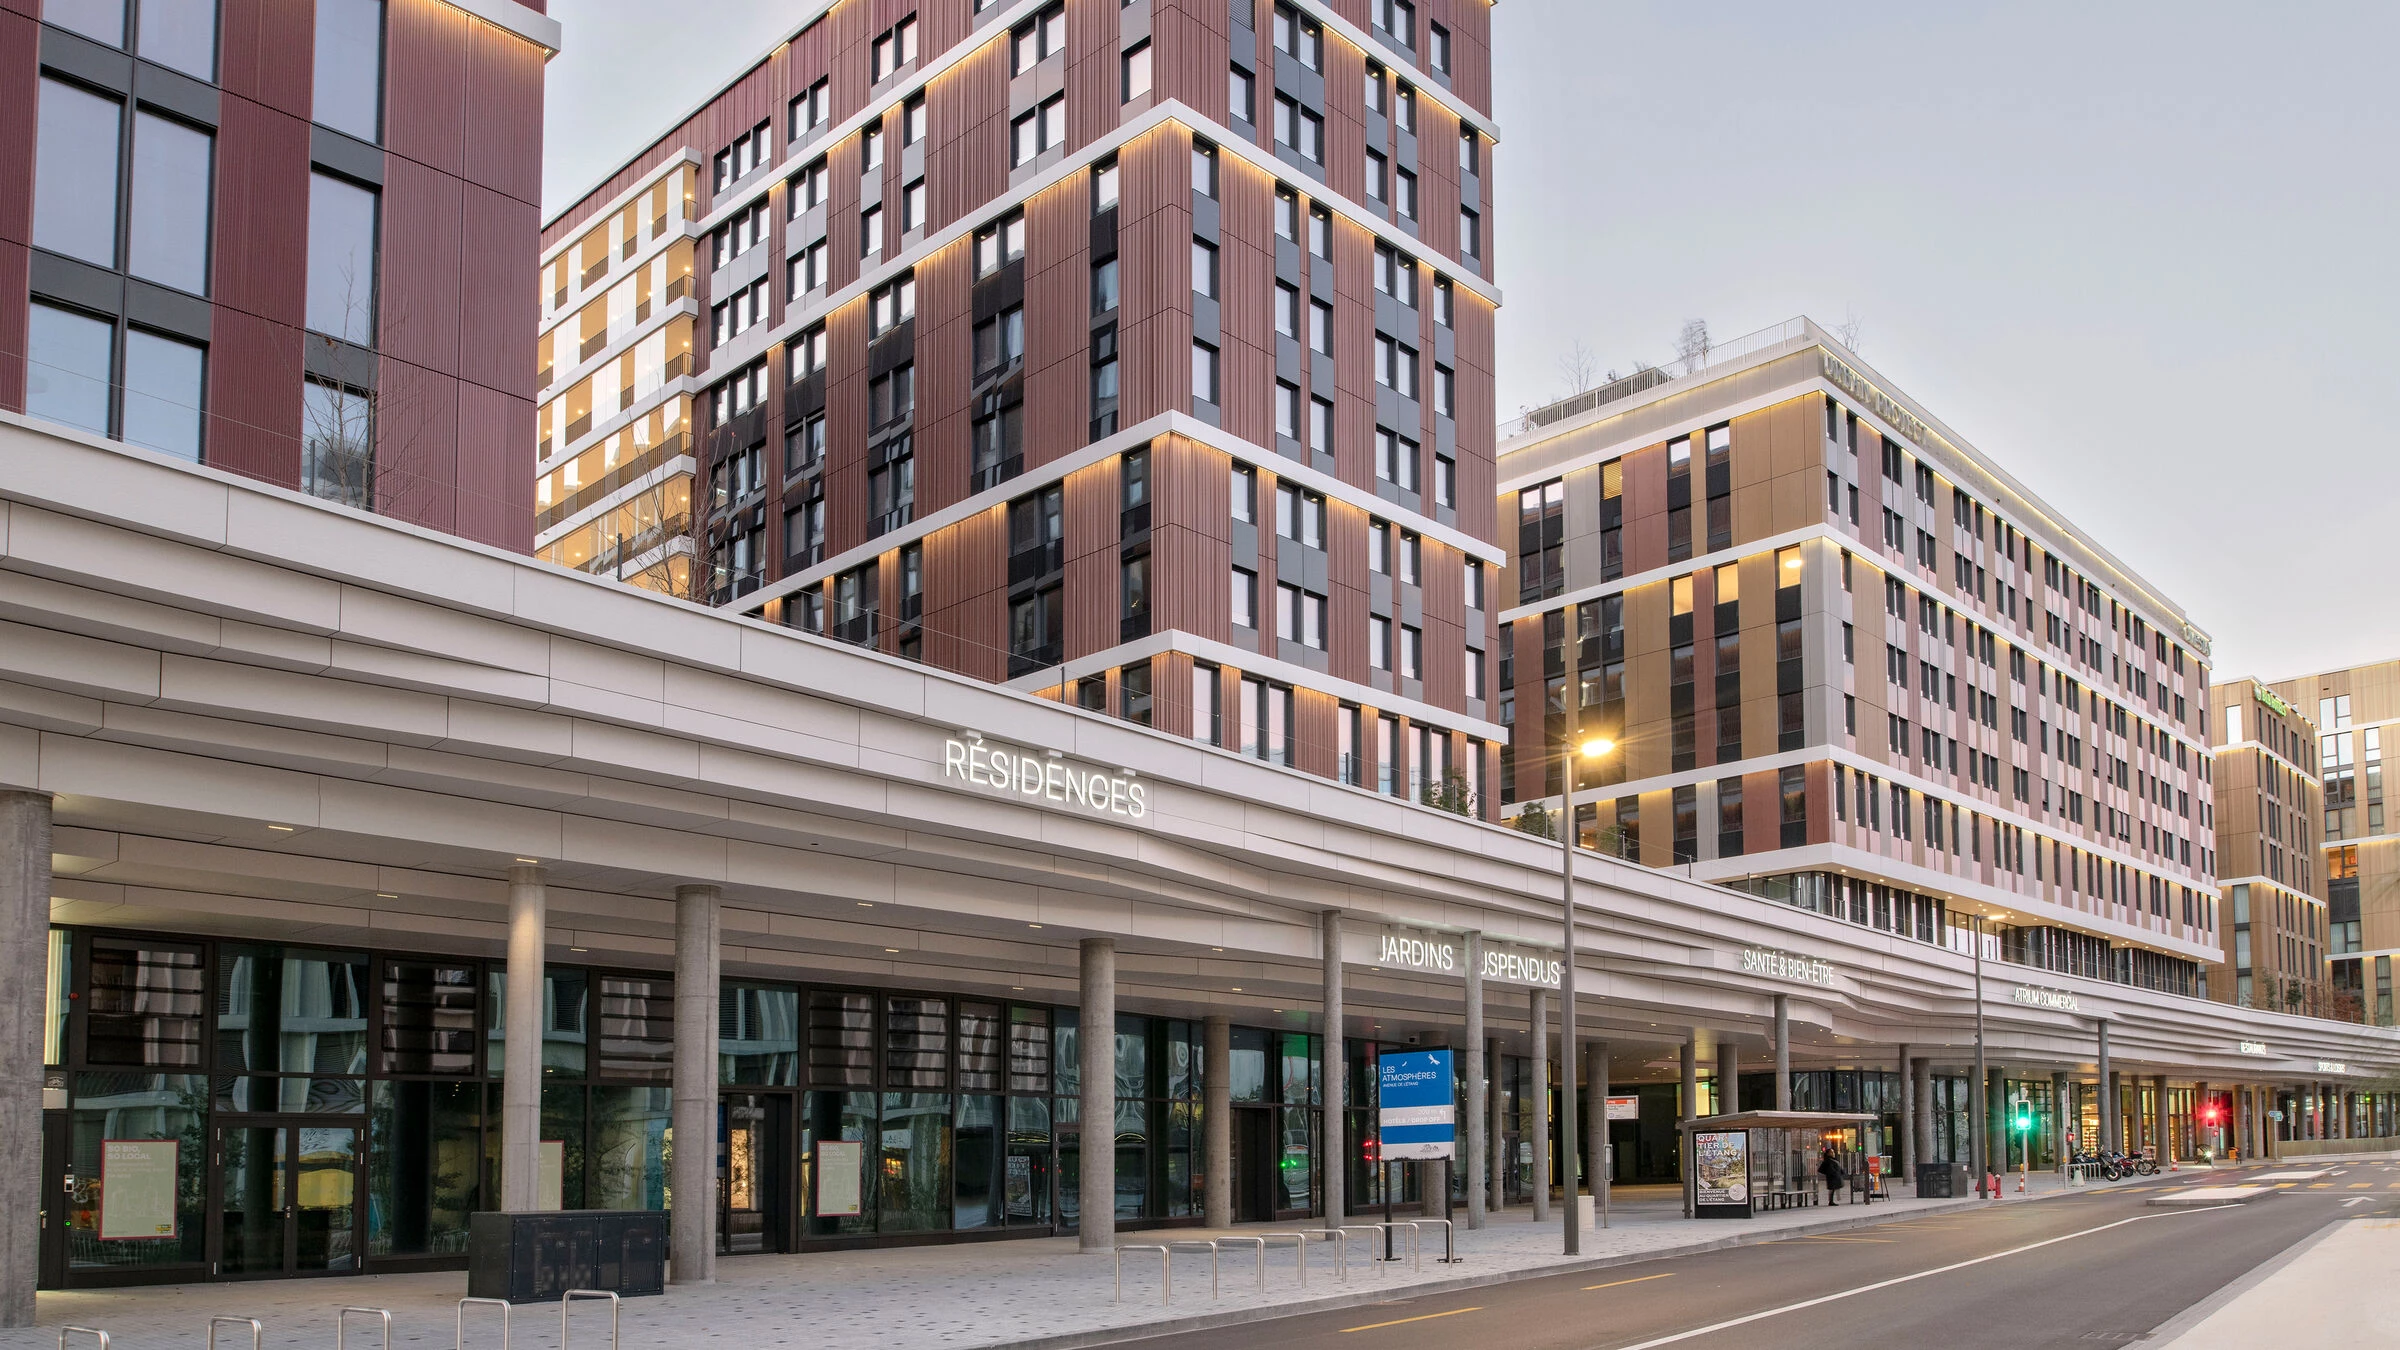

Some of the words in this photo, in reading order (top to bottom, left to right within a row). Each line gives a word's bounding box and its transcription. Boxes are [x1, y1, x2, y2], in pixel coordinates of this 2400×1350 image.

[944, 738, 1145, 818] RÉSIDENCES
[1379, 935, 1453, 970] JARDINS
[1481, 951, 1560, 985] USPENDUS
[1743, 949, 1777, 975] SANTÉ
[1779, 957, 1787, 977] &
[1788, 958, 1835, 985] BIEN-ÊTRE
[2014, 987, 2039, 1005] ATRIUM
[2040, 991, 2080, 1011] COMMERCIAL
[1382, 1066, 1395, 1074] LES
[1382, 1071, 1437, 1082] ATMOSPHÈRES
[1428, 1115, 1441, 1123] OFF
[1722, 1141, 1734, 1149] DE
